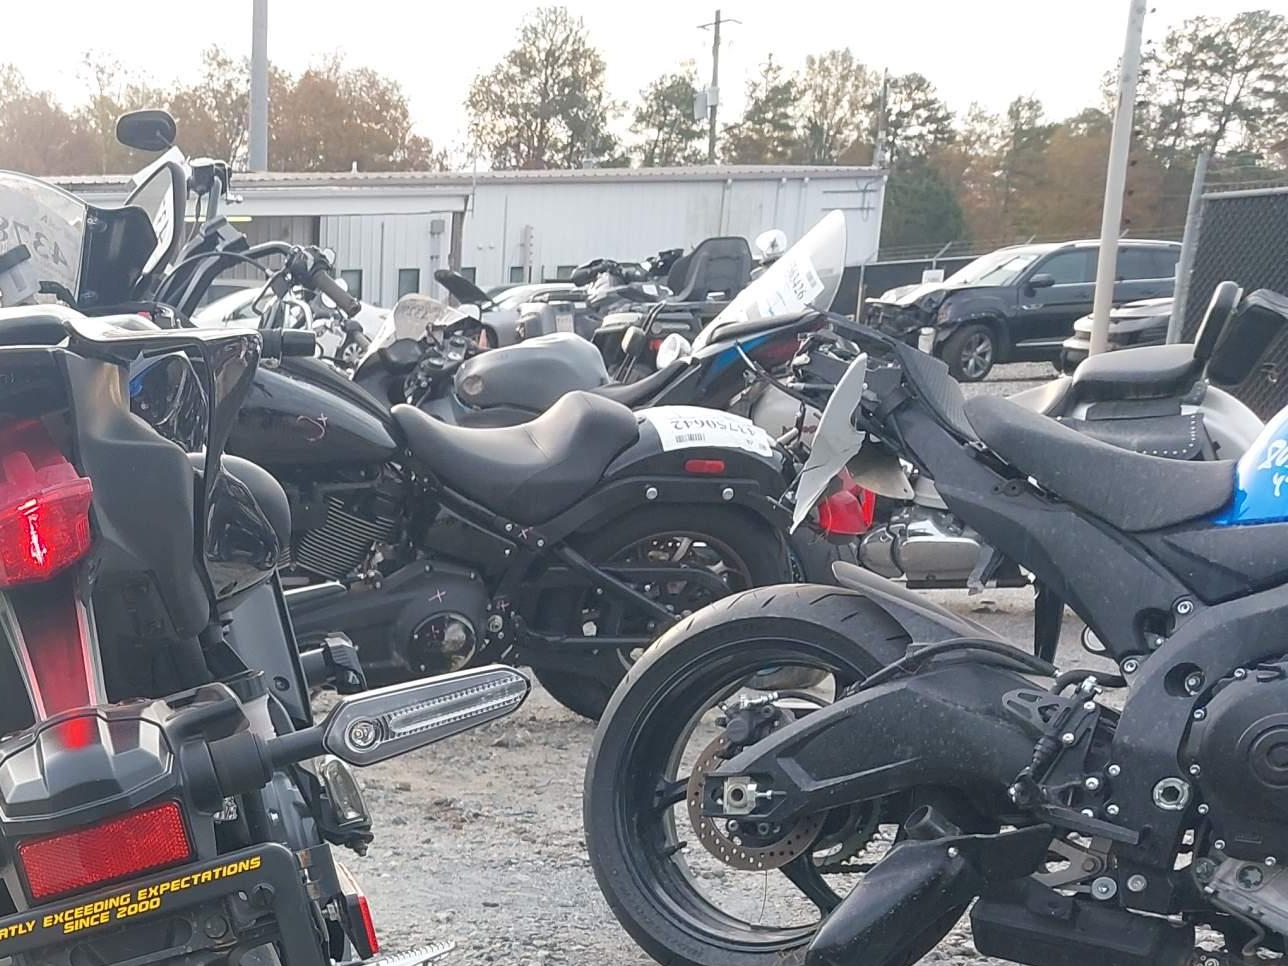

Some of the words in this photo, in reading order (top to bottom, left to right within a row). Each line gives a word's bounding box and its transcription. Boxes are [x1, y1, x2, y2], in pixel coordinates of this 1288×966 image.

[43, 893, 131, 928] EXCEEDING
[137, 856, 262, 902] EXPECTATIONS
[63, 911, 110, 934] SINCE
[116, 897, 161, 919] 2000
